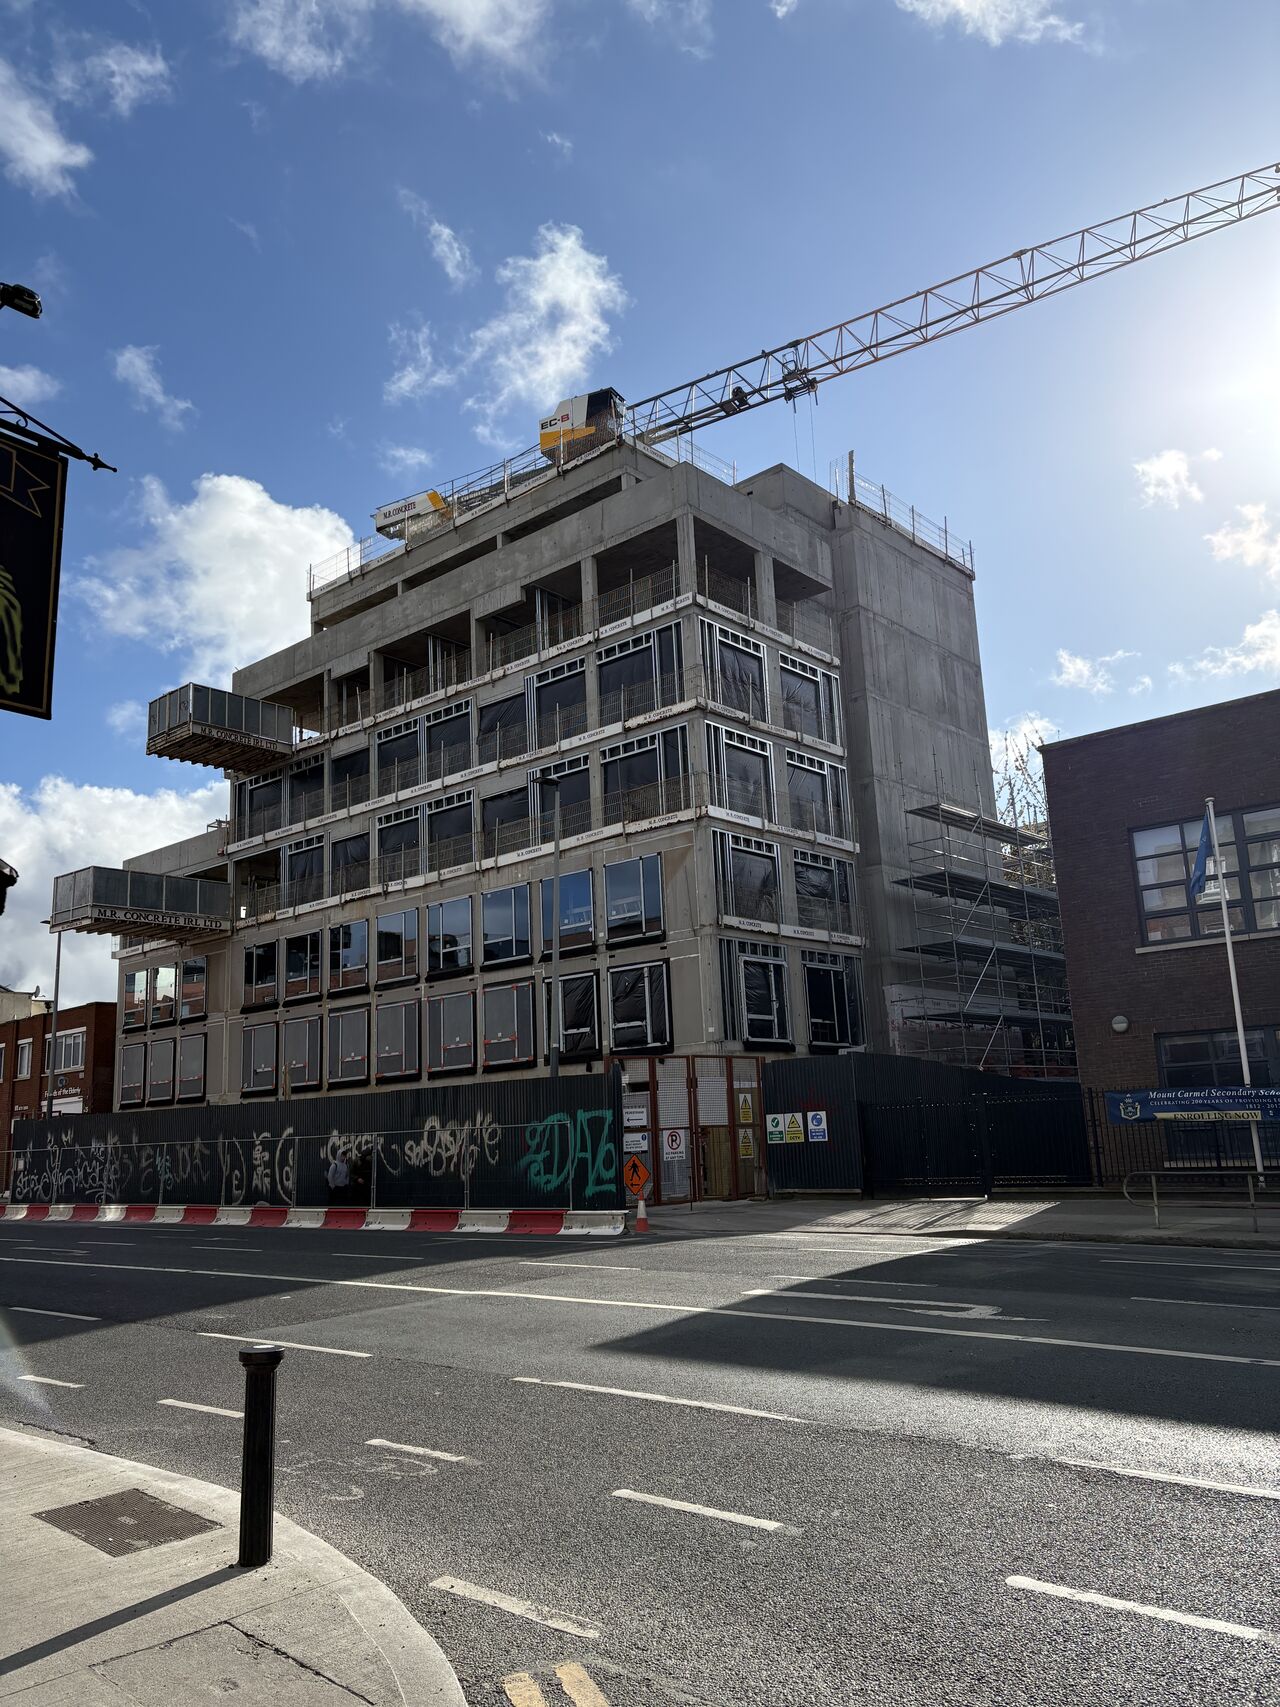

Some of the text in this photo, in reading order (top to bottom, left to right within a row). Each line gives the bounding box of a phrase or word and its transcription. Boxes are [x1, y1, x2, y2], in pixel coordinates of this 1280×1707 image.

[392, 501, 416, 516] CONCRETE
[216, 730, 252, 745] CONCRETE
[253, 738, 264, 747] IRL
[265, 741, 277, 751] LTD
[97, 908, 222, 928] M.R. CONCRETE IRL LTD
[1148, 1091, 1176, 1099] Mount
[1177, 1089, 1209, 1098] Carmel
[1210, 1089, 1257, 1098] Secondary
[1174, 1111, 1259, 1120] ENROLLING NOW
